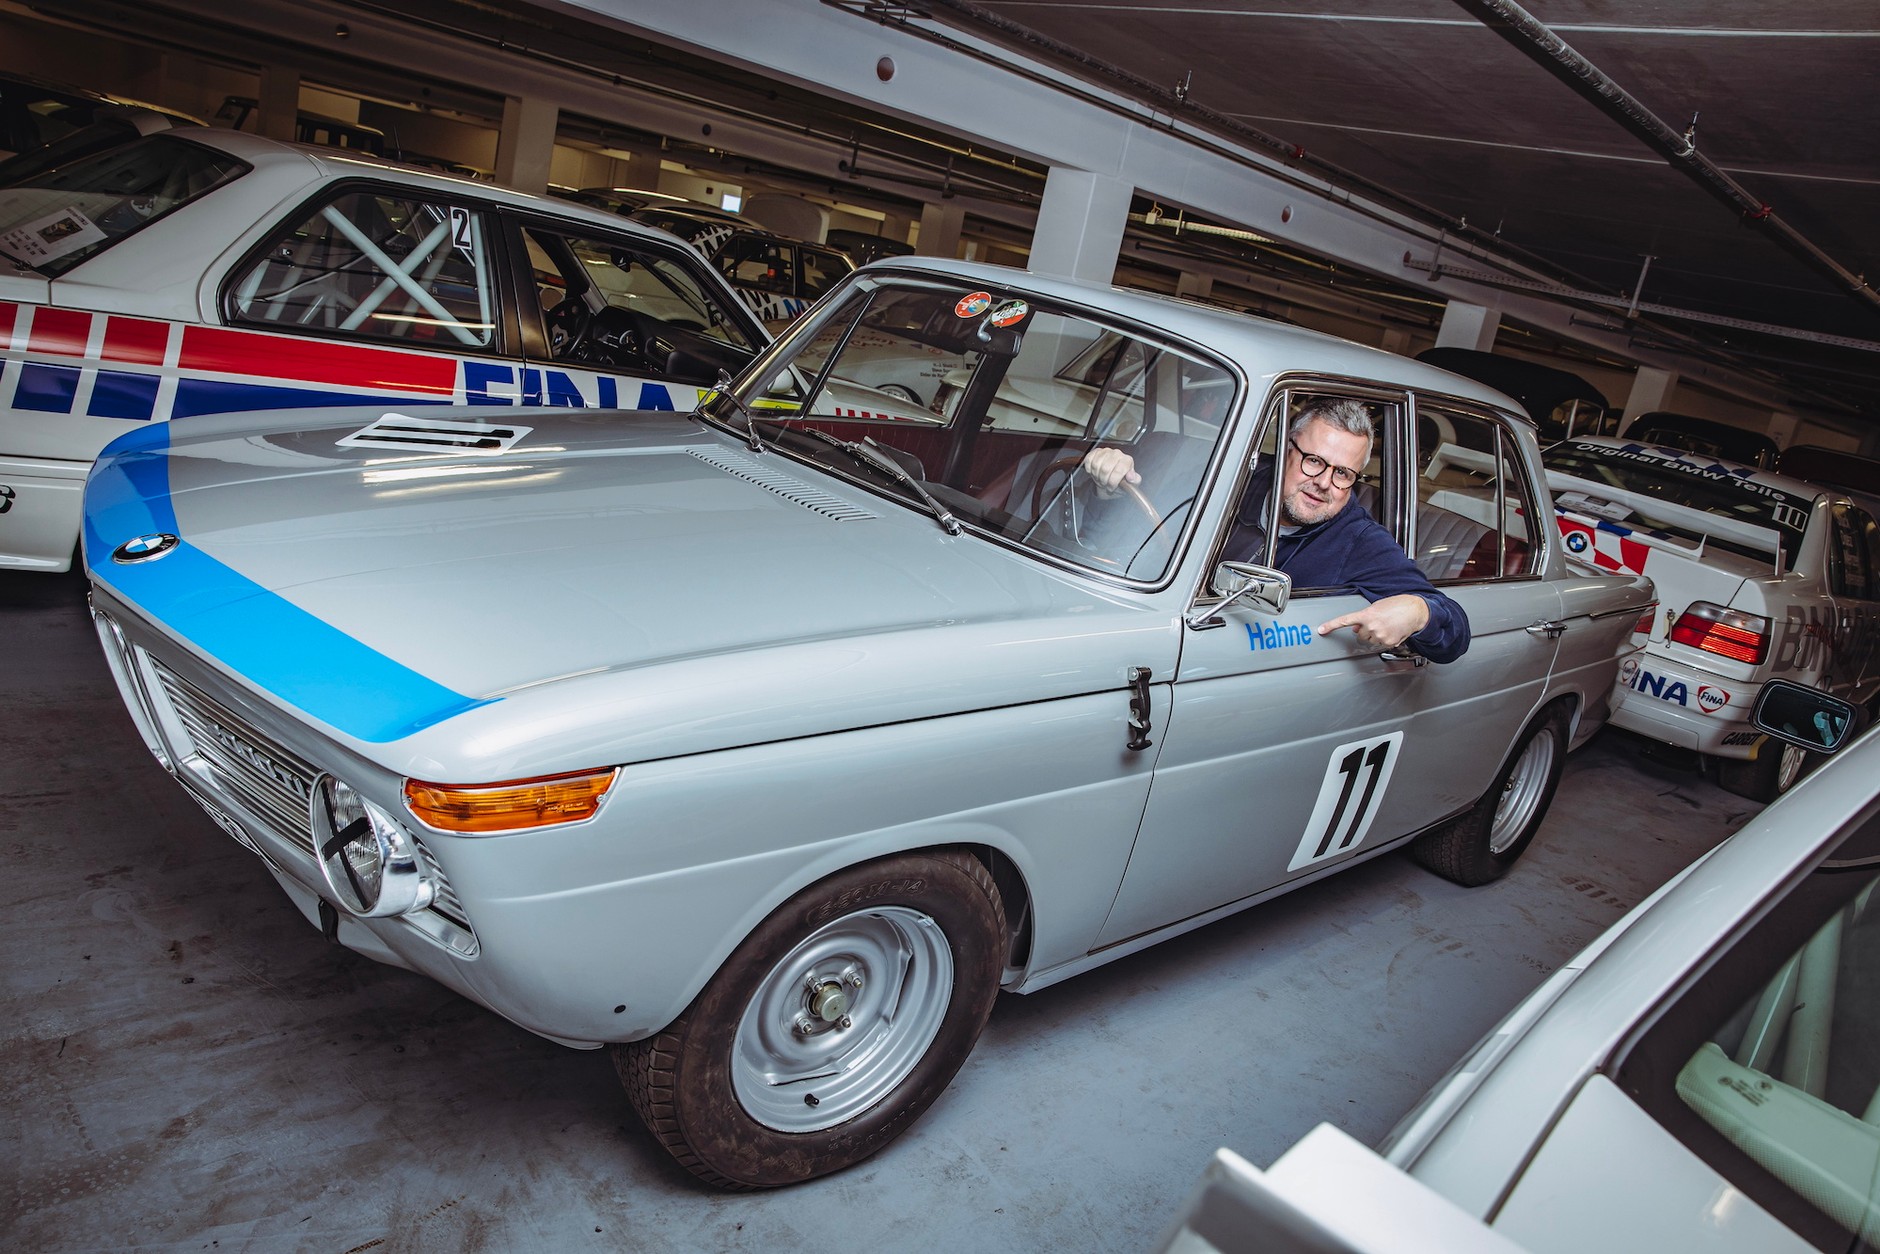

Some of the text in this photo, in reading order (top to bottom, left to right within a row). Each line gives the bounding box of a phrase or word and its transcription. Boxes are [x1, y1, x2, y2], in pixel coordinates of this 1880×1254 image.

[454, 209, 472, 248] 2
[1576, 443, 1786, 501] Original BMW Teile
[1777, 504, 1807, 531] 10
[1244, 620, 1312, 651] Hahne
[1700, 691, 1724, 706] FINA
[1312, 740, 1391, 859] 11
